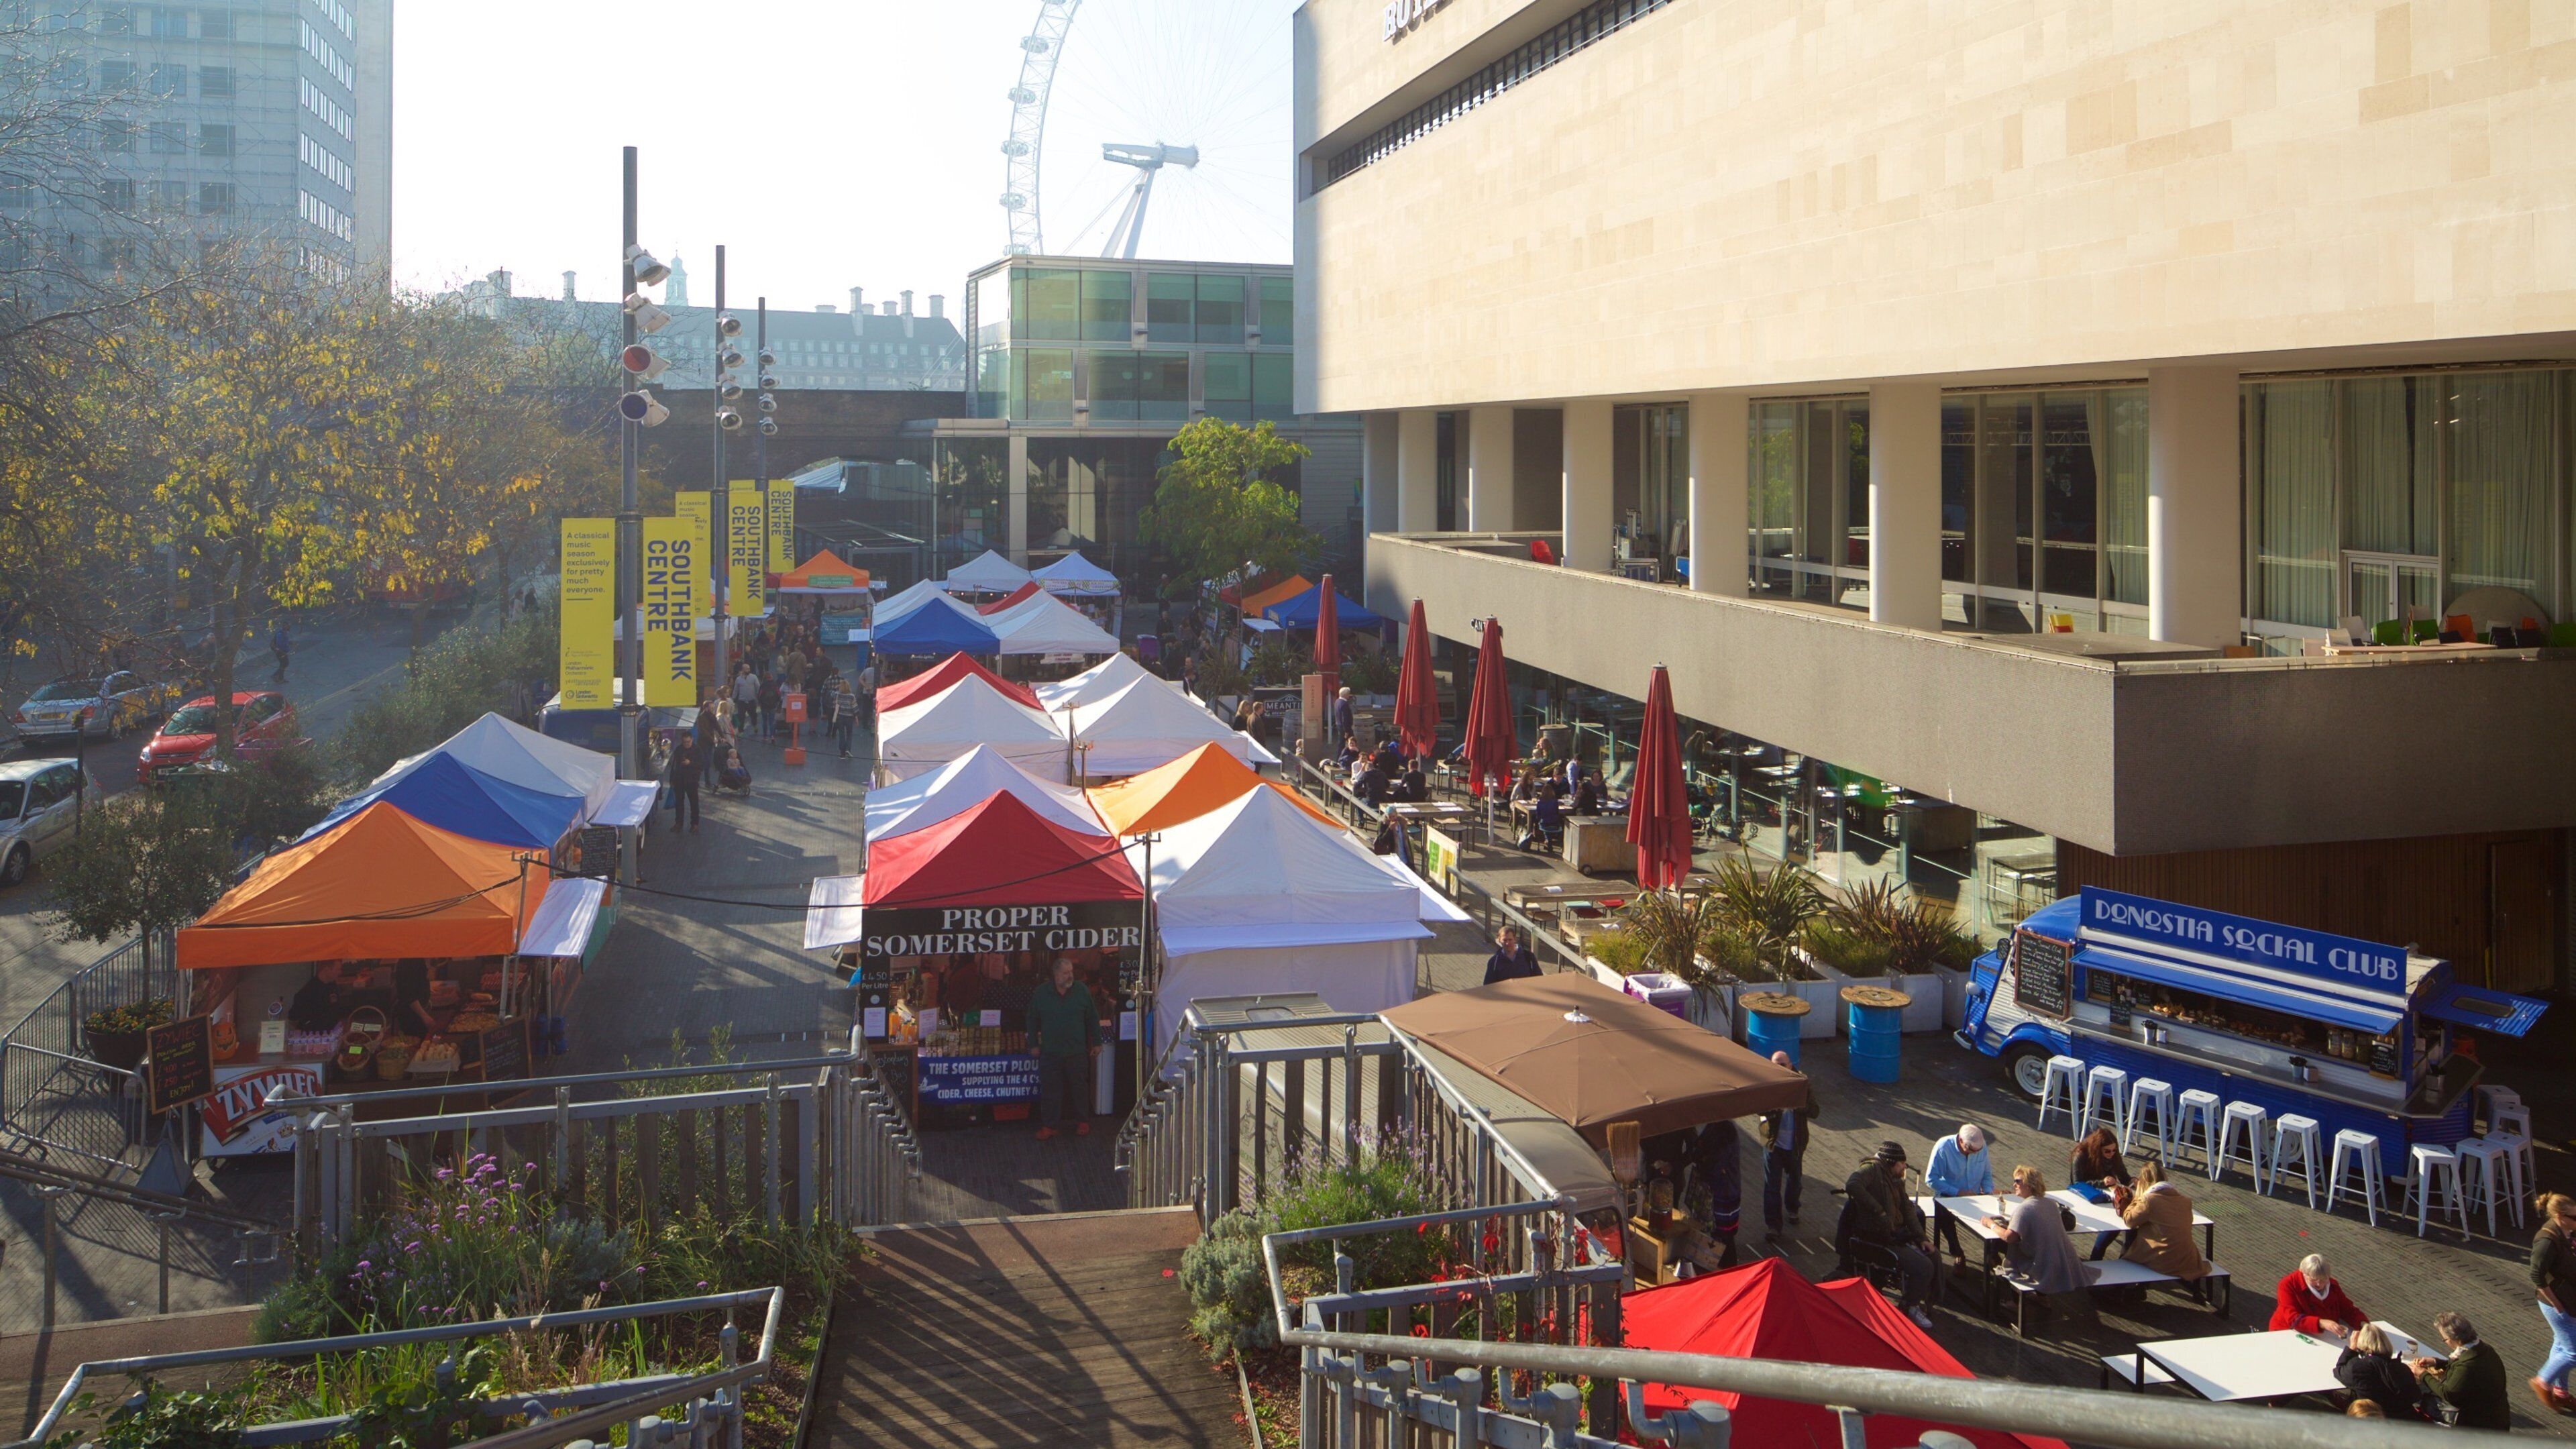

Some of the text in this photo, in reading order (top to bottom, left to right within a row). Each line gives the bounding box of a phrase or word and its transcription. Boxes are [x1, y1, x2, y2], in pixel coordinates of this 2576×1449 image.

[732, 506, 745, 567] CENTRE
[771, 490, 782, 536] CENTRE
[782, 490, 793, 561] SOUTHBANK
[747, 506, 761, 600] SOUTHBANK
[647, 540, 668, 633] CENTRE
[670, 540, 692, 682] SOUTHBANK
[867, 926, 1142, 957] SOMERSET CIDER
[941, 906, 1070, 930] PROPER
[2094, 899, 2399, 981] DONOSTIA SOCIAL CLUB
[929, 1059, 1039, 1075] THE SOMERSET PLOU
[937, 1087, 1038, 1099] CIDER, CHEESE, CHUTNEY &
[962, 1075, 1004, 1085] SUPPLYING
[1006, 1075, 1020, 1084] THE
[1022, 1074, 1027, 1083] 4
